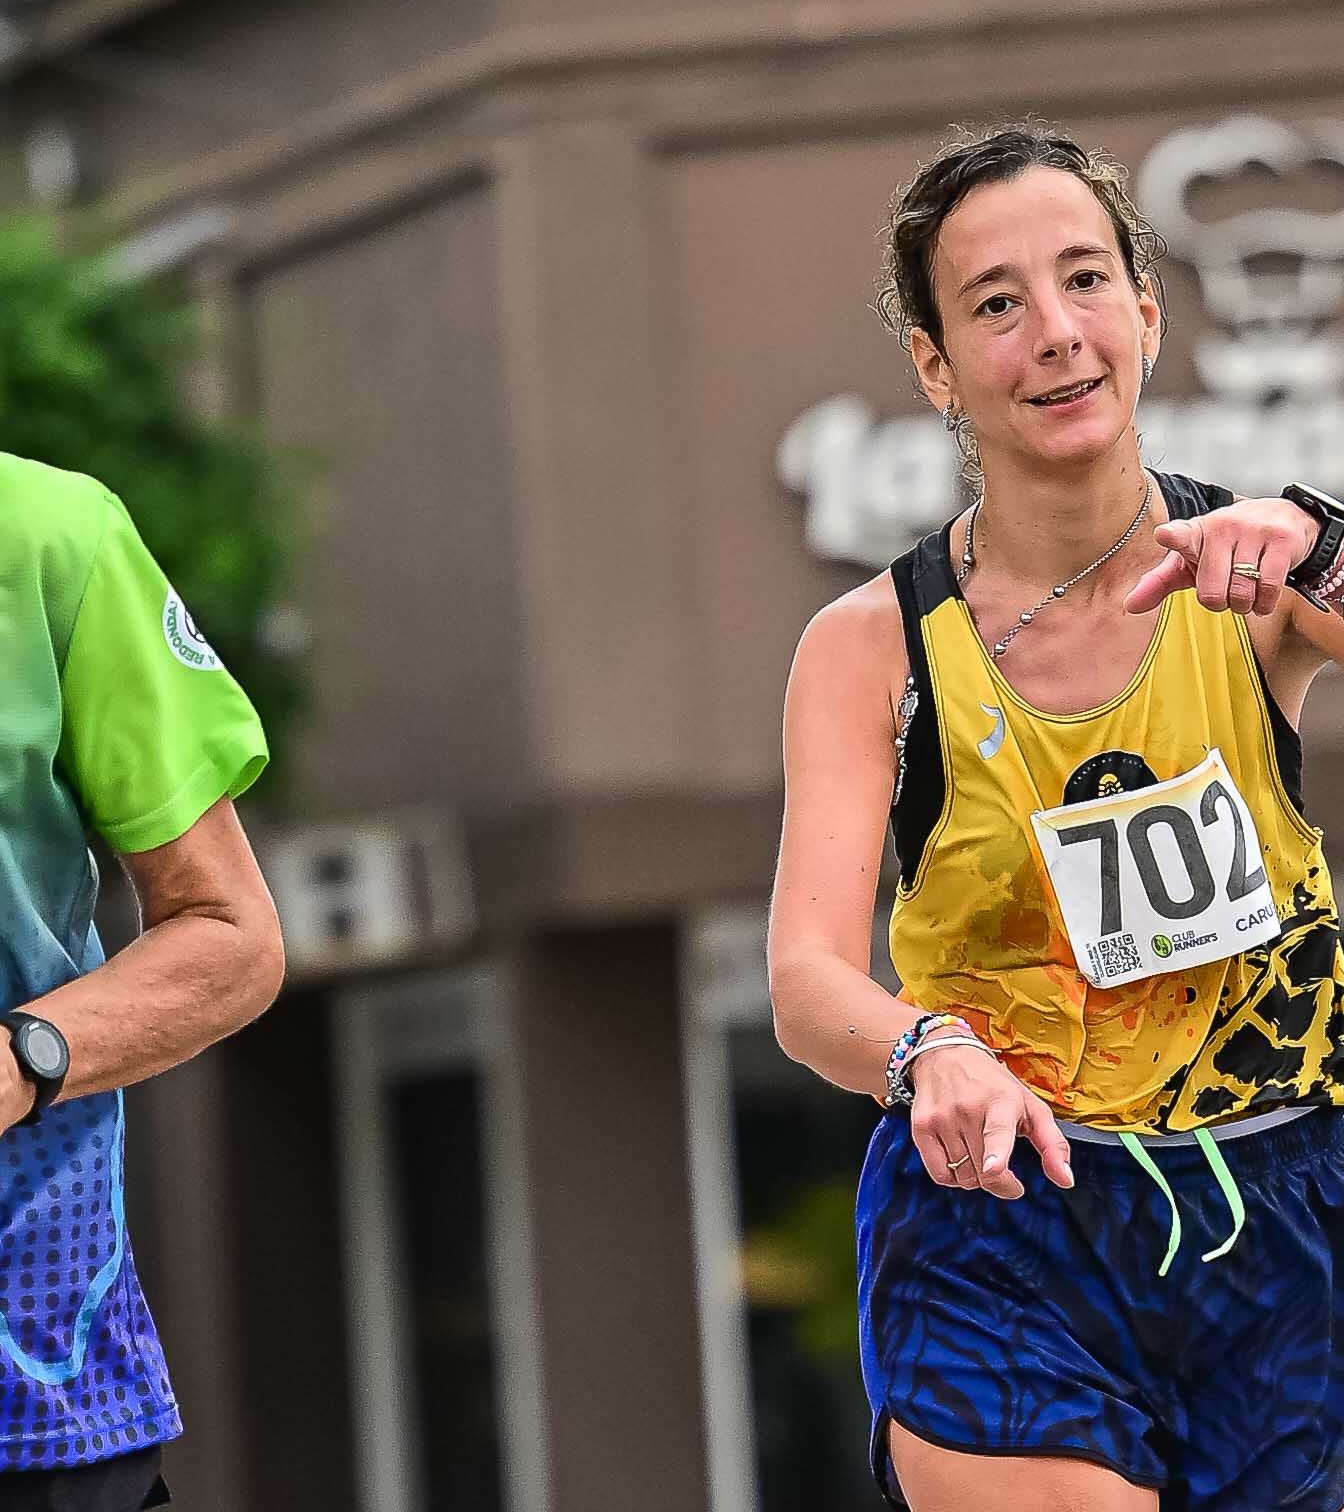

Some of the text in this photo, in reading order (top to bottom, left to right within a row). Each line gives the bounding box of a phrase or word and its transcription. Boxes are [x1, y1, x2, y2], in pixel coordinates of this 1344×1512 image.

[1056, 780, 1266, 936] 702
[1235, 904, 1274, 931] CARU
[1172, 930, 1195, 942] CLUB
